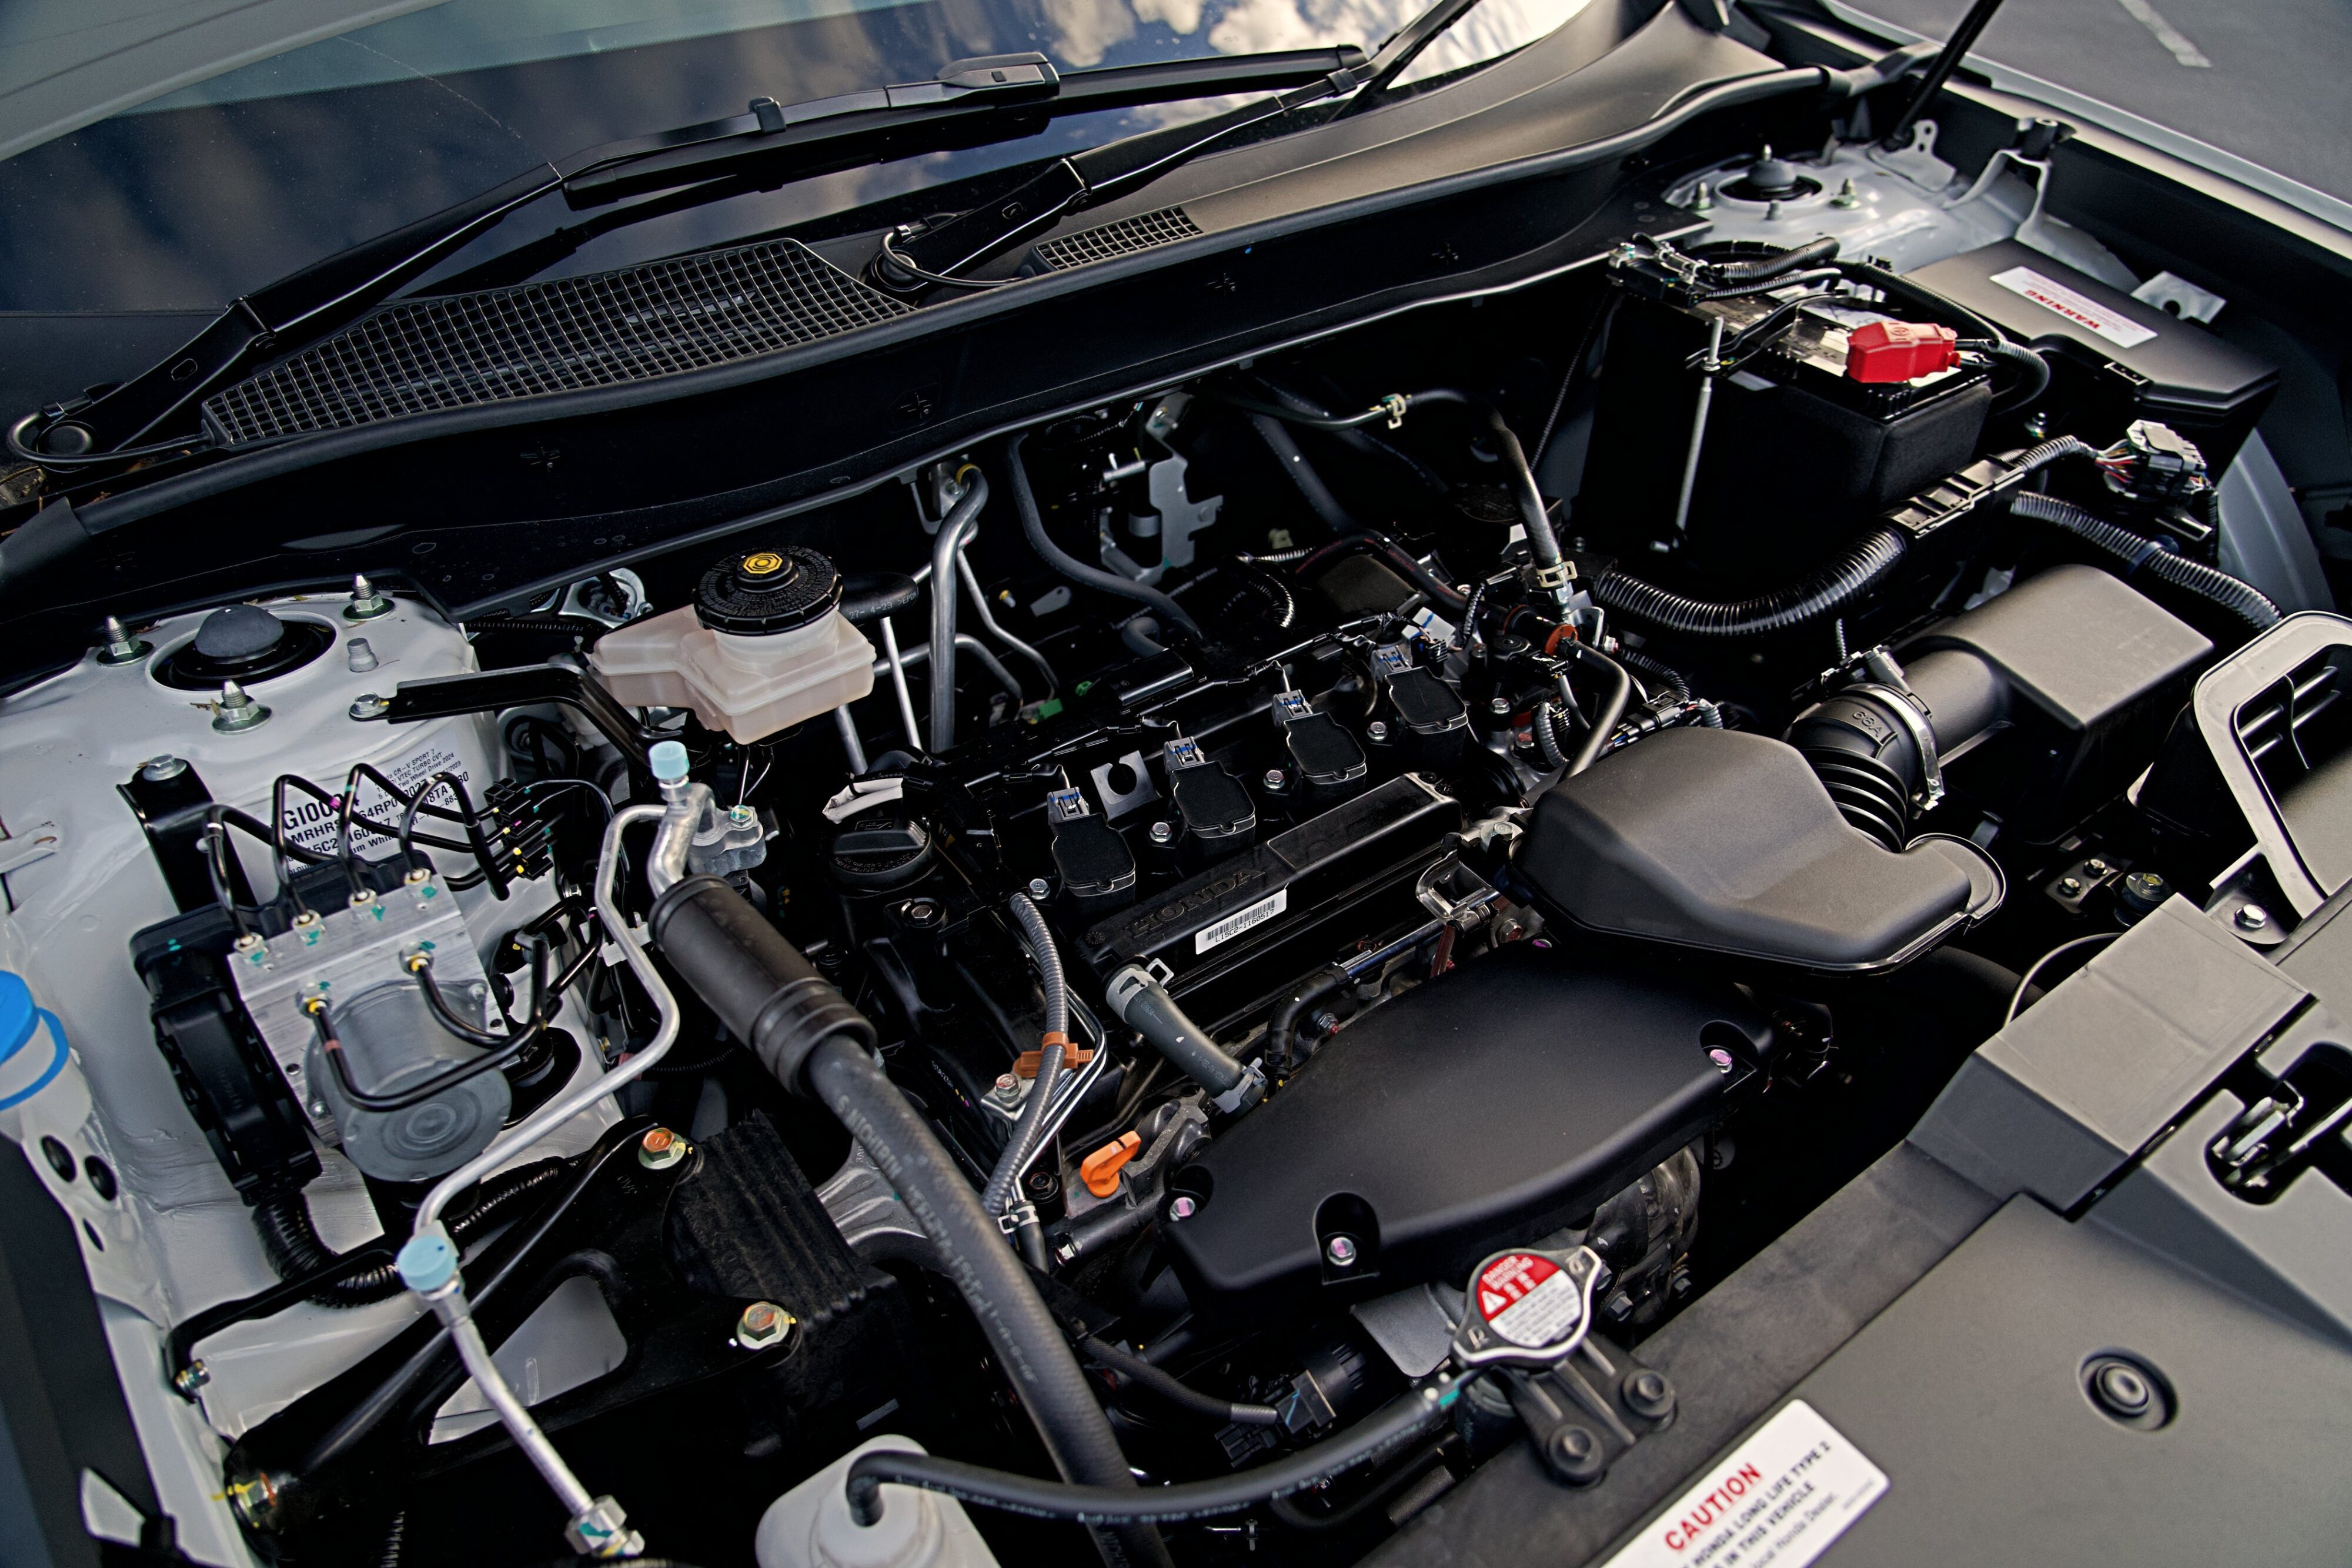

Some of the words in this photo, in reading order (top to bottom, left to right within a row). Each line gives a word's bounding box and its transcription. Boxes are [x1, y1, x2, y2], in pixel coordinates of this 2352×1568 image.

[2024, 289, 2101, 329] WARNING
[397, 771, 412, 781] VTEC
[413, 759, 431, 772] TURBO
[432, 751, 443, 762] CVT
[410, 770, 427, 783] Wheel
[428, 761, 442, 772] Drive
[442, 752, 455, 762] 2024
[412, 752, 430, 766] SPORT
[1122, 870, 1265, 938] HONDA
[1664, 1462, 1763, 1552] CAUTION
[1733, 1496, 1769, 1529] LONG
[1764, 1475, 1793, 1501] LIFE
[1789, 1447, 1824, 1478] TYPE
[1819, 1440, 1832, 1453] 2
[1738, 1524, 1769, 1553] THIS
[1765, 1479, 1816, 1527] VEHICLE
